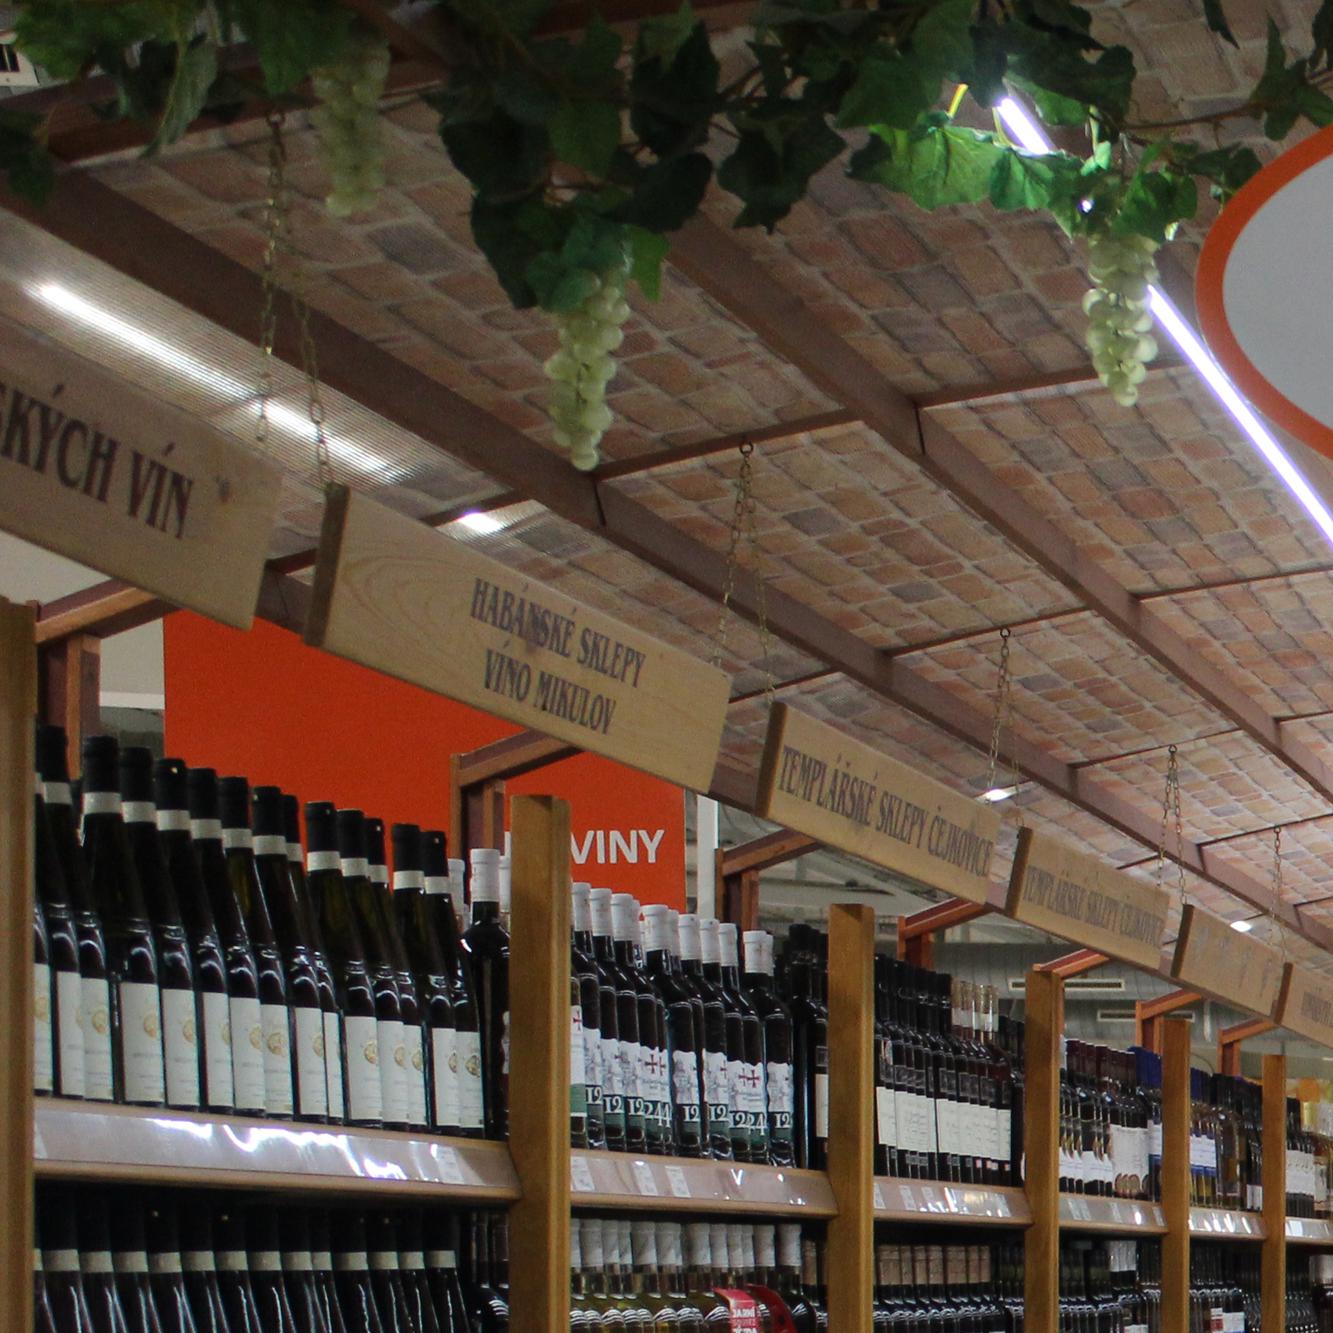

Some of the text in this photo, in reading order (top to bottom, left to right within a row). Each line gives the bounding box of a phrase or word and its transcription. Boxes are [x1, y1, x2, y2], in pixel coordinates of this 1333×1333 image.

[0, 382, 194, 539] KÝCH VÍN
[469, 577, 647, 689] HABÁNSKÉ SKLEPY
[483, 638, 617, 735] VÍNO MIKULOV
[571, 829, 665, 865] VINY
[875, 790, 929, 849] SKLEPY
